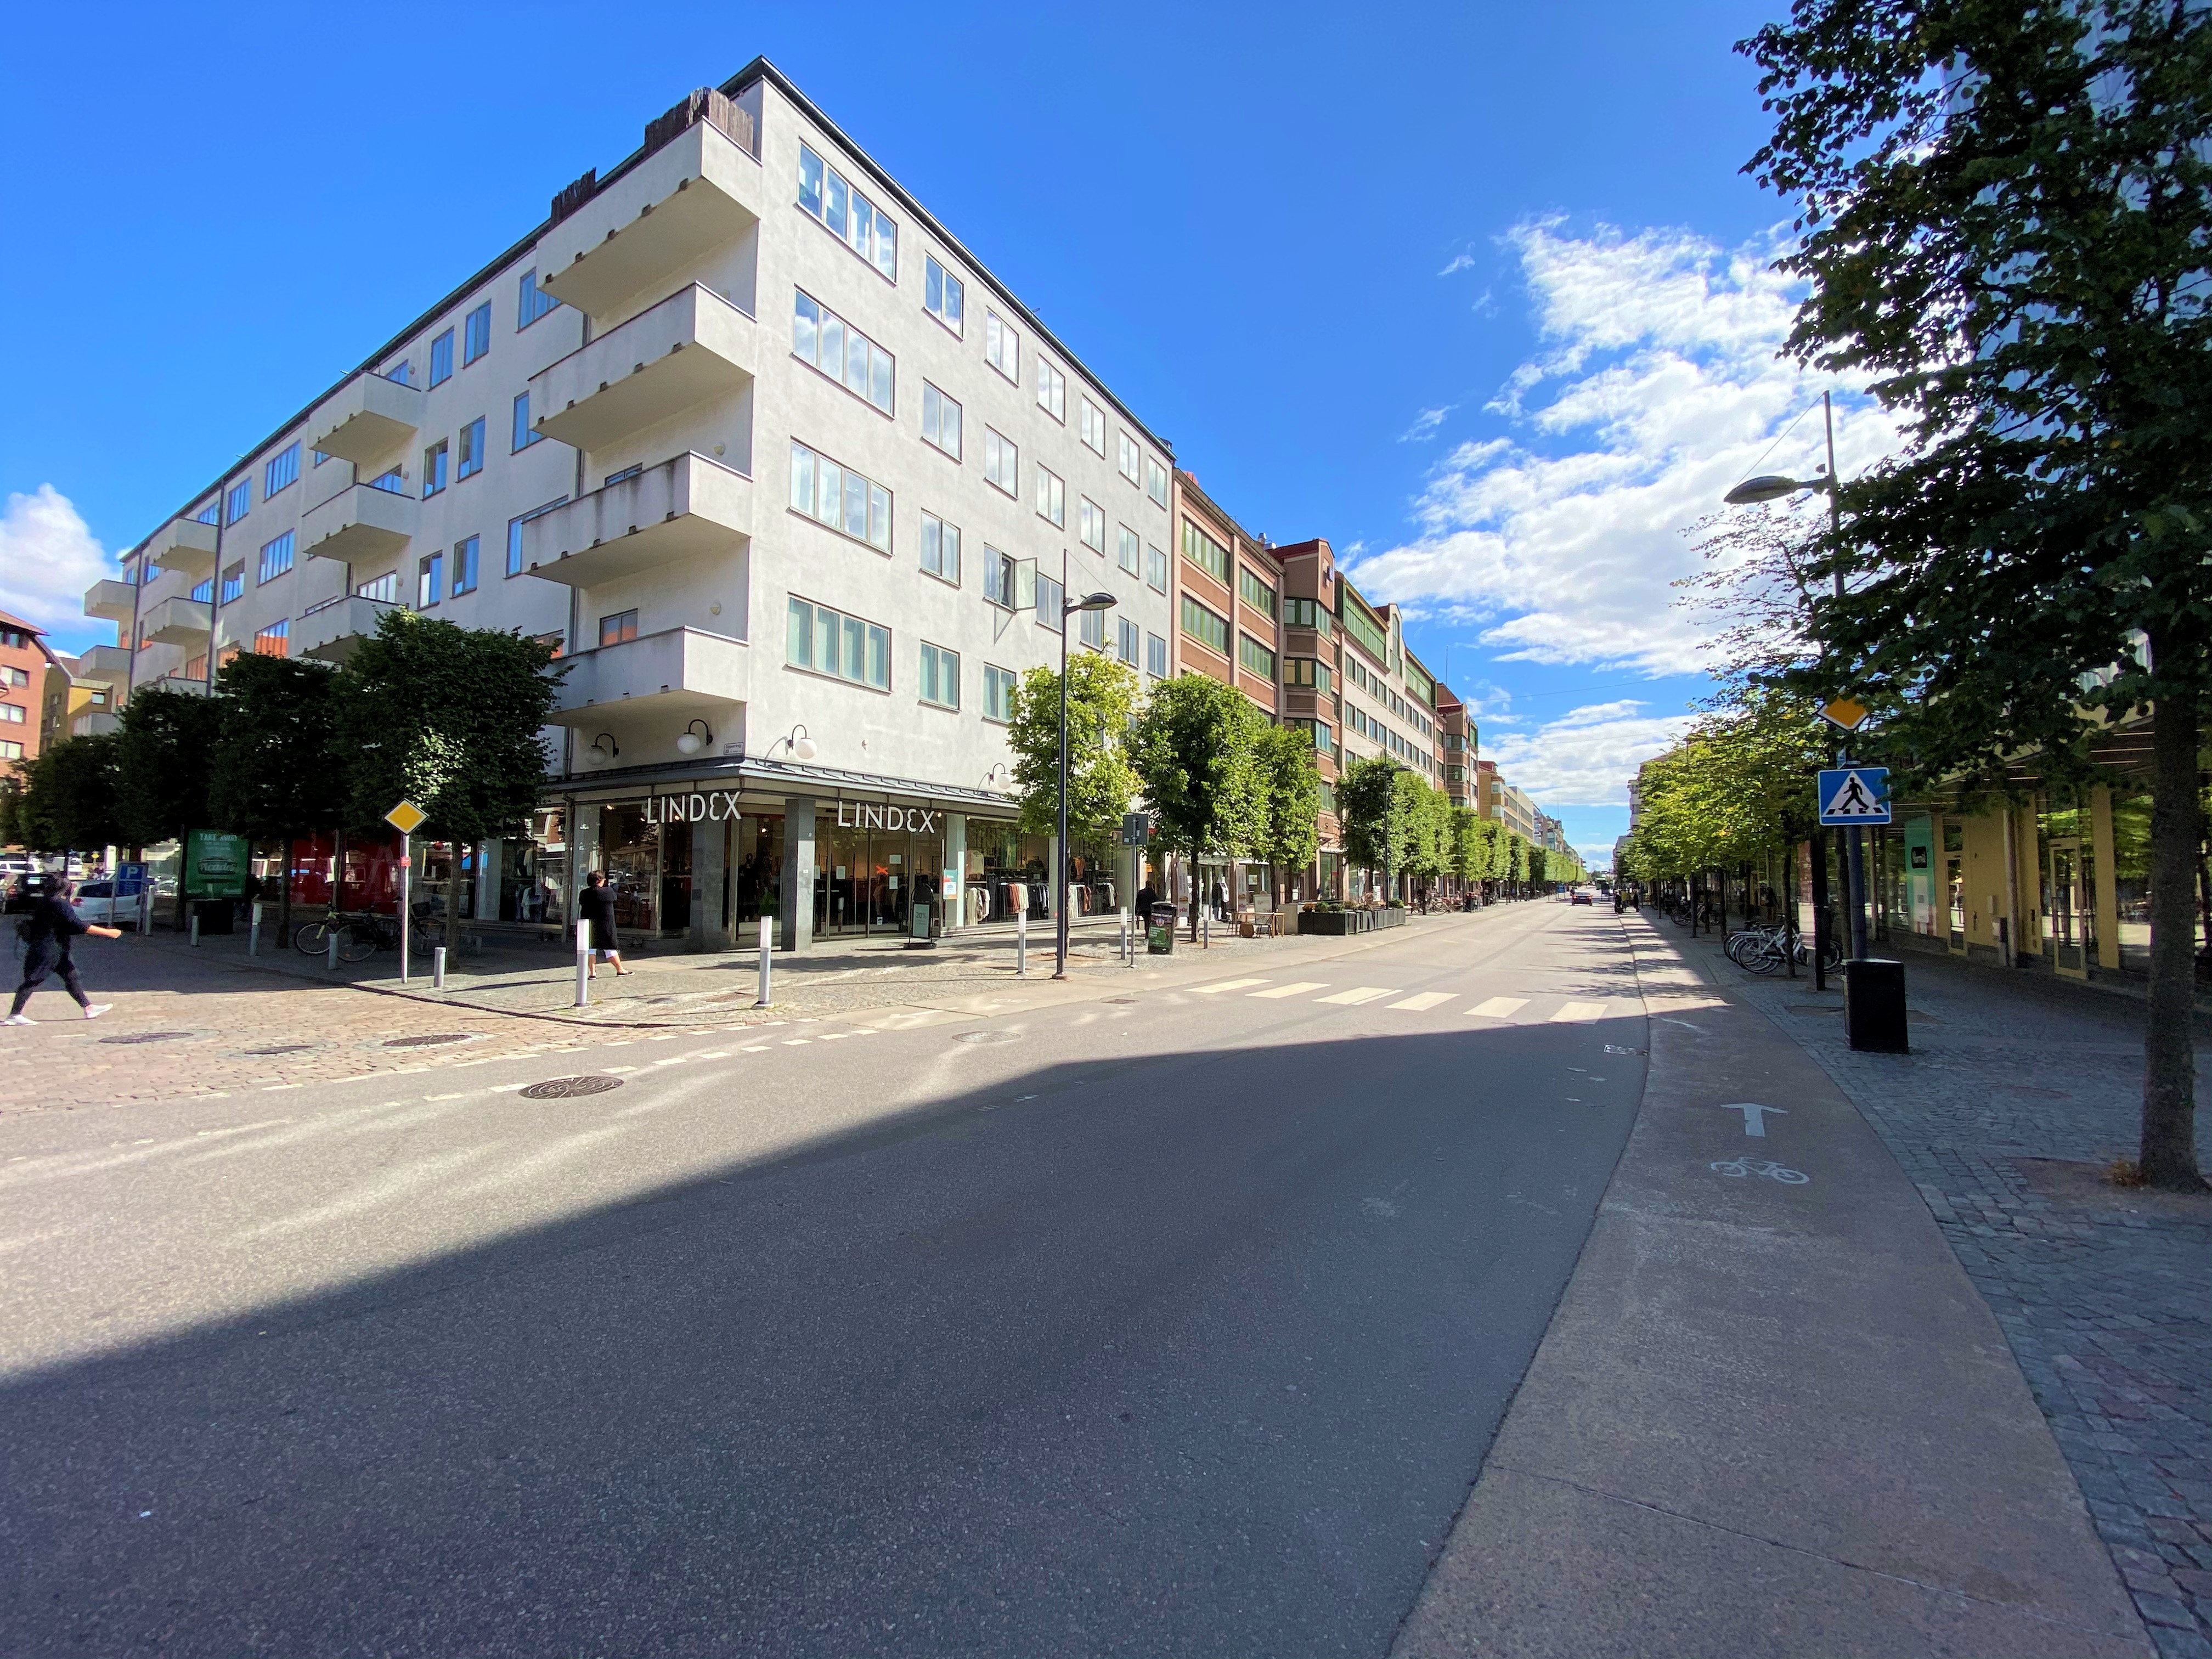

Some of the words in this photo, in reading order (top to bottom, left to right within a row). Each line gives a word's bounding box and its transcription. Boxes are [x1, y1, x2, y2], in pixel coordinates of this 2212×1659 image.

[647, 791, 742, 824] LINDEX
[838, 801, 935, 833] LINDEX
[126, 866, 138, 878] P
